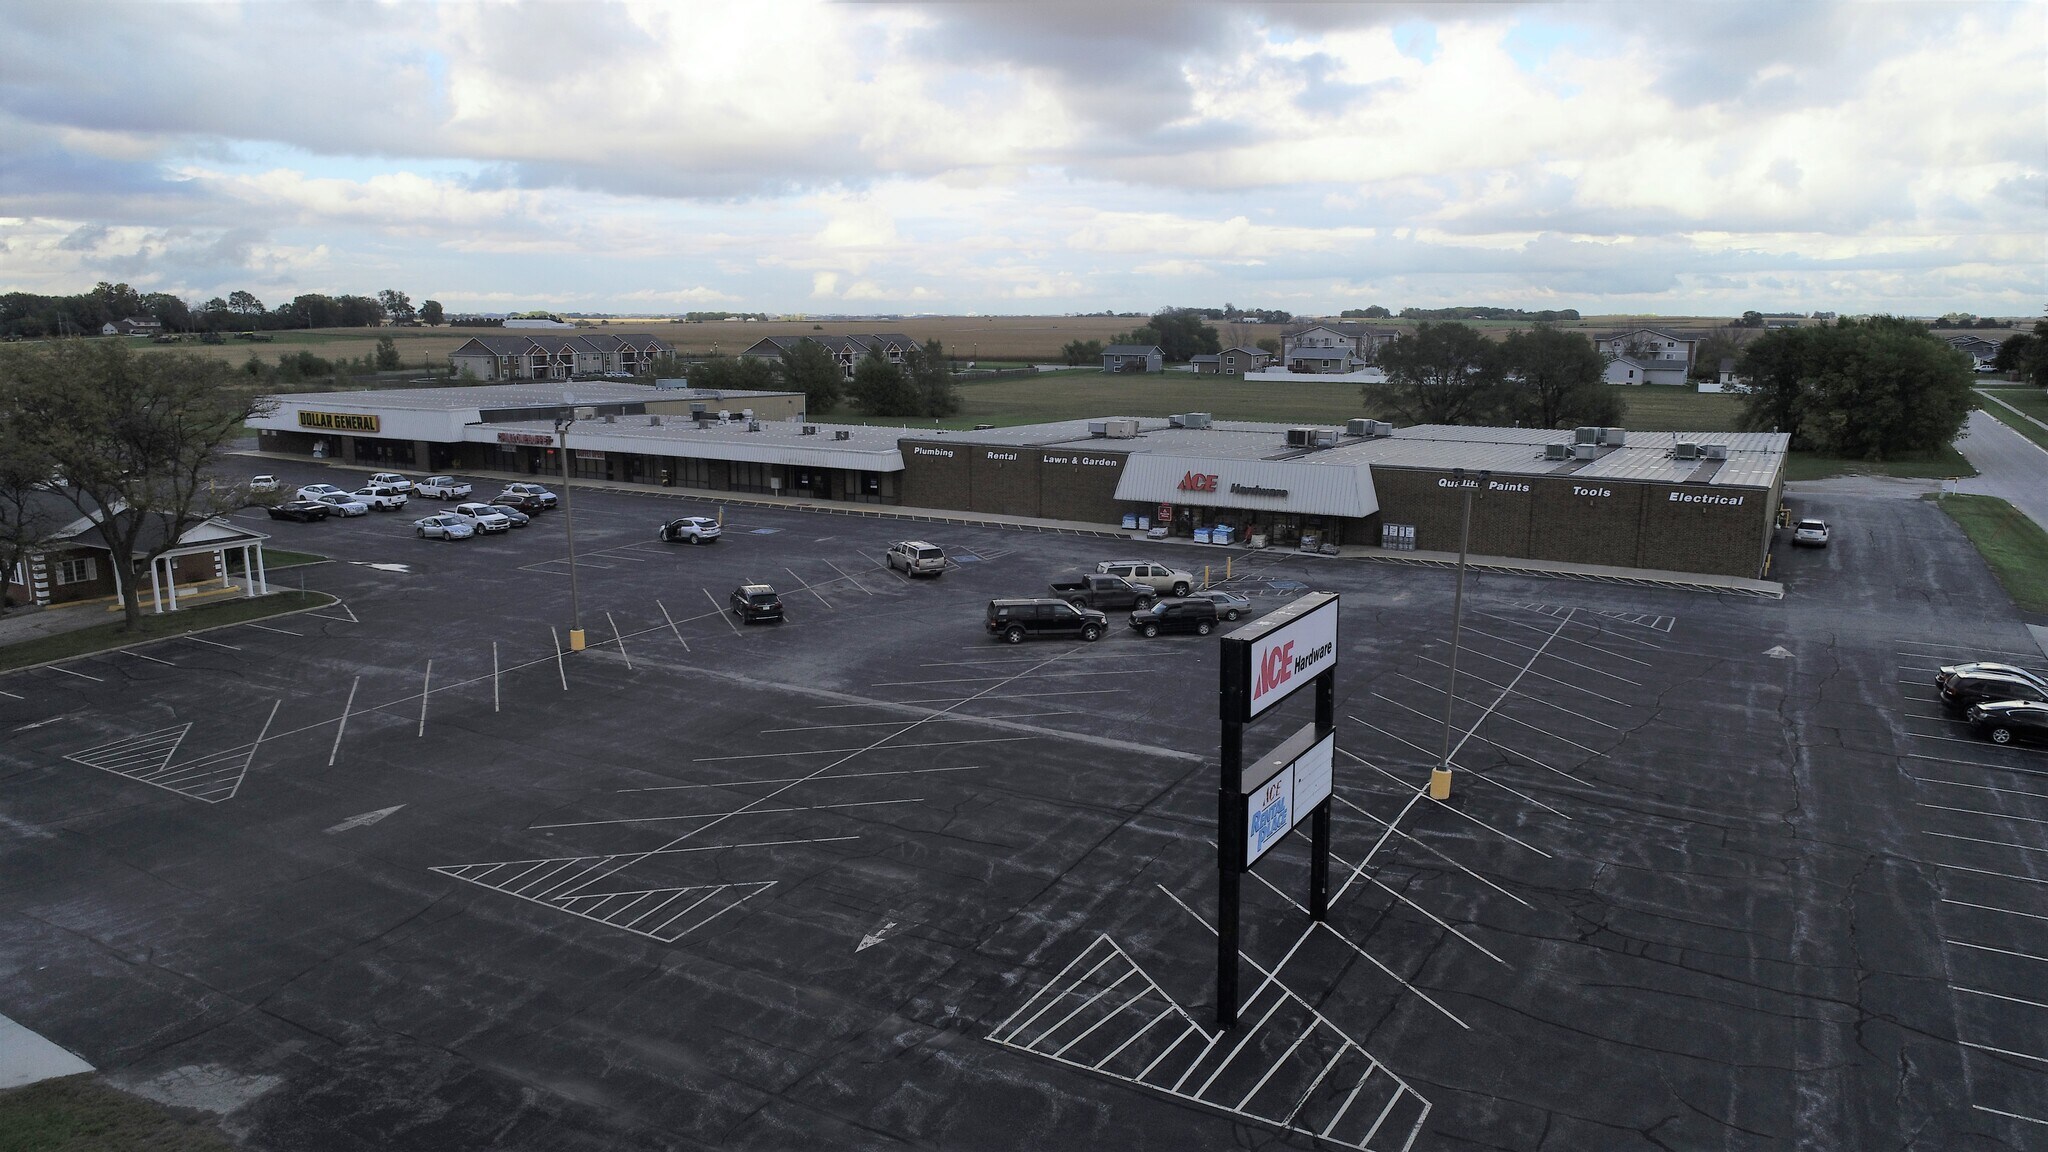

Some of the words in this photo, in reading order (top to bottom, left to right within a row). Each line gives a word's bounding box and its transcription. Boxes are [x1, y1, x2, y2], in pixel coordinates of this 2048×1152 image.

[300, 412, 333, 428] DOLLAR
[334, 415, 375, 431] GENERAL
[914, 446, 954, 458] Plumbing
[987, 451, 1018, 461] Rental
[1043, 454, 1068, 464] Lawn
[1072, 456, 1078, 465] &
[1082, 457, 1117, 467] Garden
[1177, 470, 1218, 493] ACE
[1230, 483, 1288, 498] Hardware
[1438, 478, 1480, 488] Qualit
[1488, 481, 1530, 492] Paints
[1573, 486, 1611, 497] Tools
[1669, 491, 1744, 507] Electrical
[1254, 640, 1294, 700] ACE
[1294, 641, 1332, 675] Hardware
[1262, 780, 1282, 807] ACE
[1250, 796, 1286, 838] RENTAL
[1257, 808, 1288, 853] PLACE
